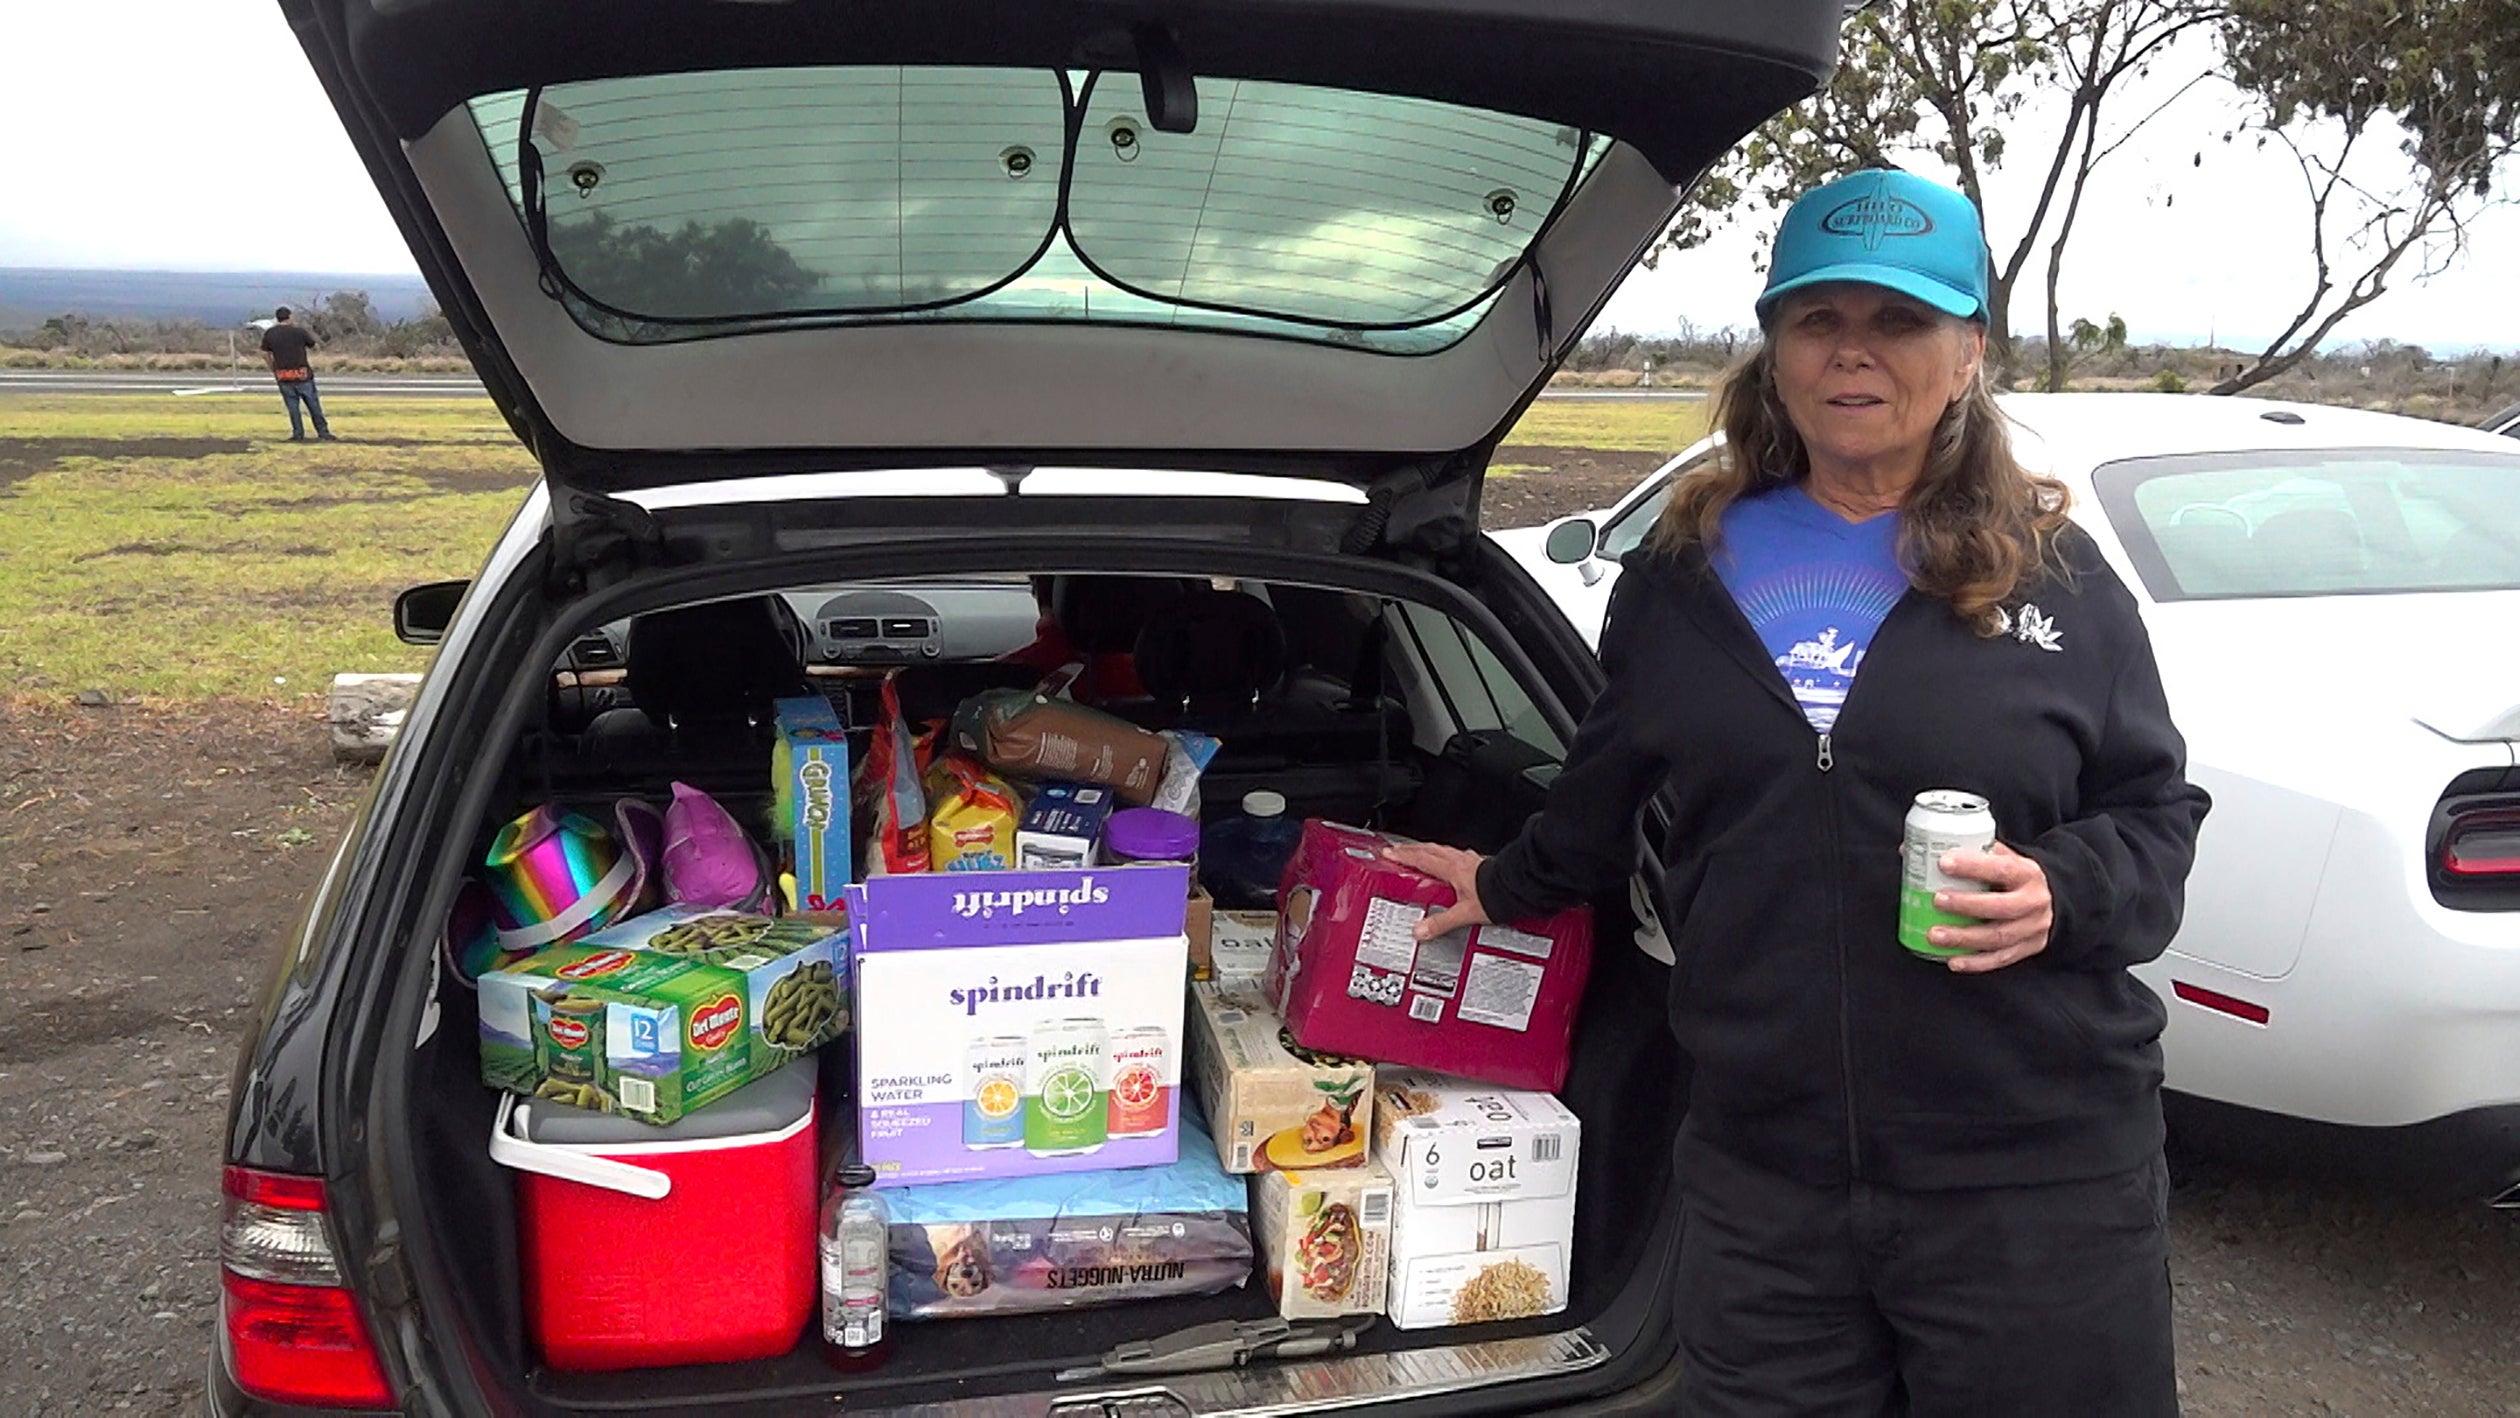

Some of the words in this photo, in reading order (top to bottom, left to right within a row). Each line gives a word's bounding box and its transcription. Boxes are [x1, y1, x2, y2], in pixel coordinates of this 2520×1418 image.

[952, 876, 1110, 918] spindrift
[949, 972, 1103, 1016] spindrift
[633, 1018, 655, 1041] 12
[871, 1073, 953, 1090] SPARKLING
[871, 1088, 924, 1103] WATER
[1425, 1141, 1441, 1167] 6
[1469, 1154, 1518, 1182] oat
[1045, 1262, 1186, 1290] NUTRA-NUGGETS
